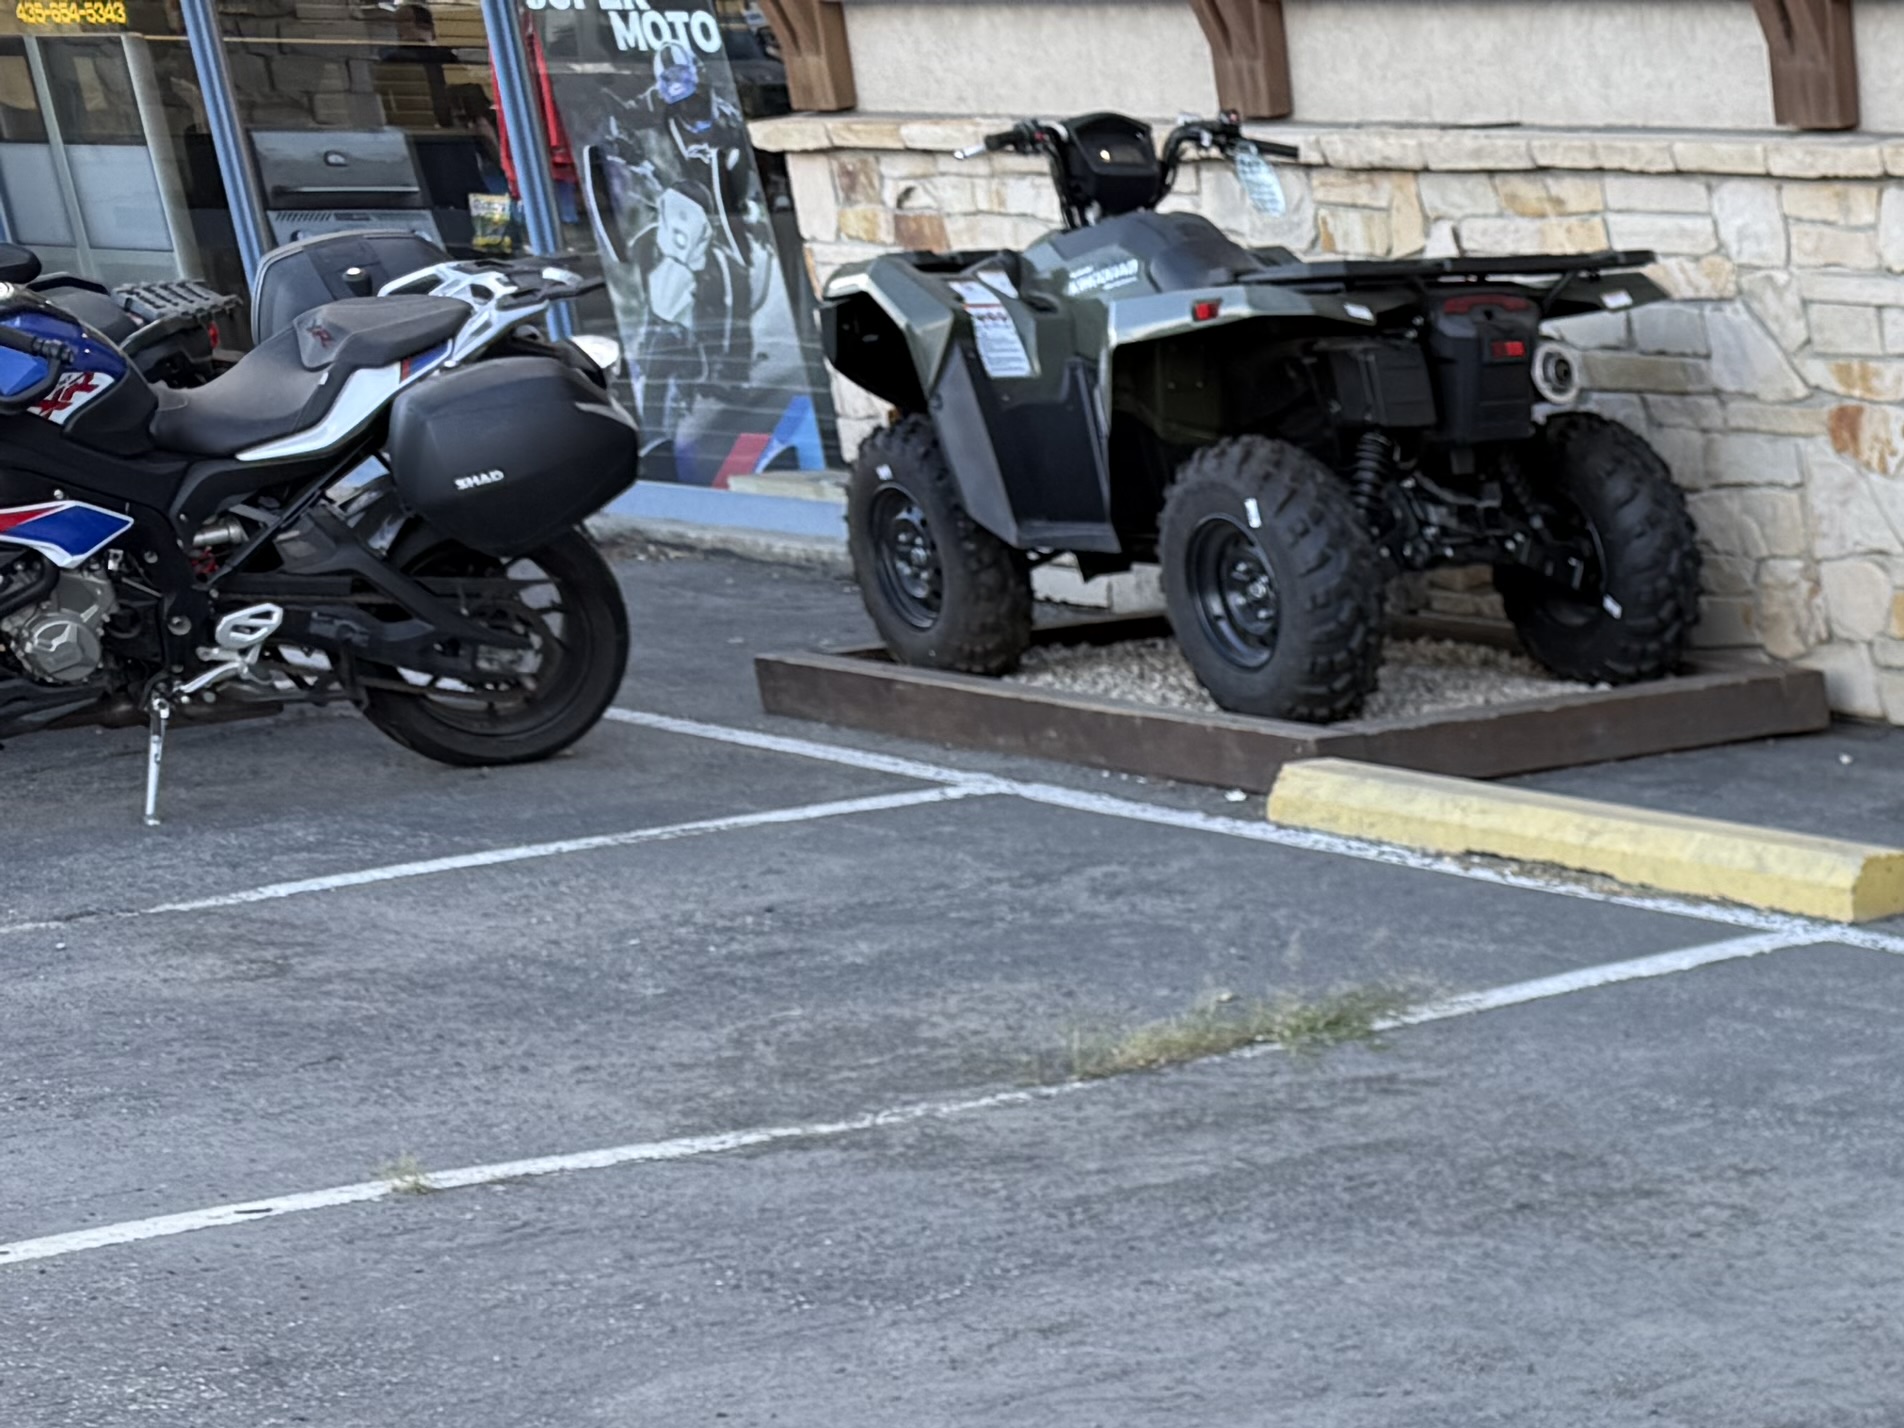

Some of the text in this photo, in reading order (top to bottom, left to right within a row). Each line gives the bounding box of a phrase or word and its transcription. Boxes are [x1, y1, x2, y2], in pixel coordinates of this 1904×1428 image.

[16, 1, 127, 25] 435-654-5343
[608, 10, 722, 53] MOTO
[454, 469, 505, 491] SHAD
